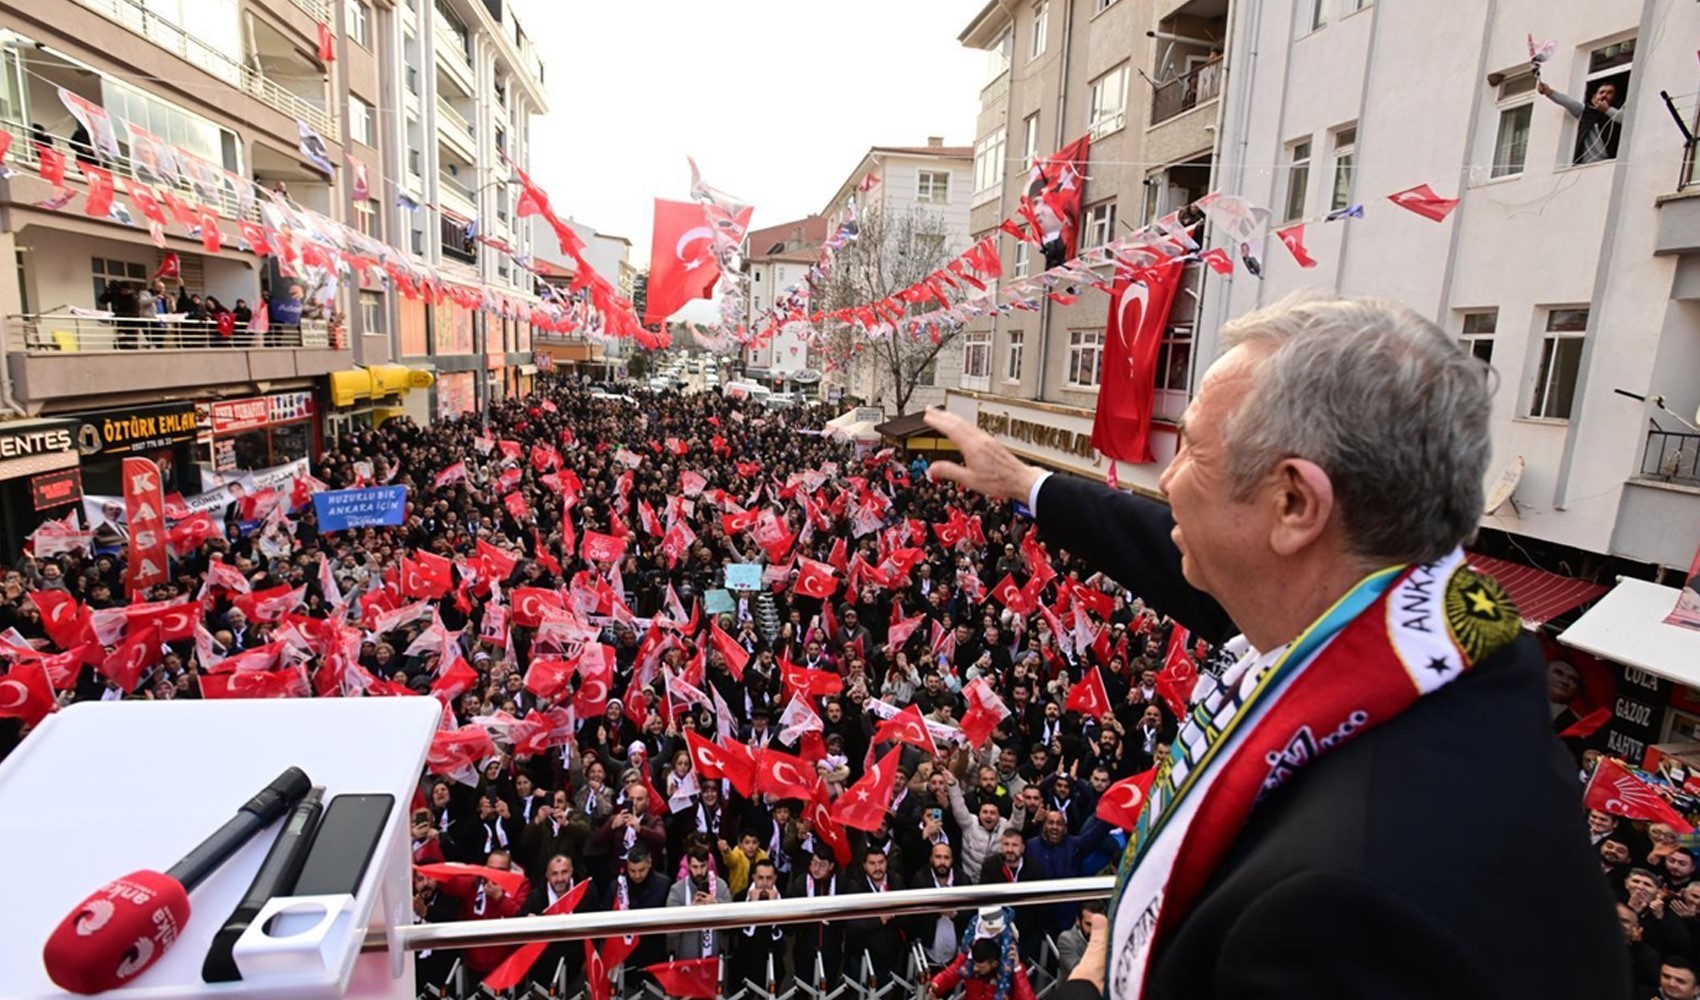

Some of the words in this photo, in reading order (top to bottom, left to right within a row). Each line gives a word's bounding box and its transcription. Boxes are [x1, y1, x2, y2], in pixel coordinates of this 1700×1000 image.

[103, 415, 157, 443] ÖZTÜRK
[159, 411, 197, 434] EMLAK
[0, 429, 72, 457] ENTEŞ
[328, 492, 376, 504] HUZURLU
[377, 489, 396, 500] BİR
[328, 506, 373, 517] ANKARA
[376, 501, 399, 511] İÇİN
[1401, 559, 1441, 634] ANKA
[1624, 665, 1659, 692] COLA
[1615, 698, 1652, 727] GAZOZ
[1607, 730, 1644, 761] KAHVE
